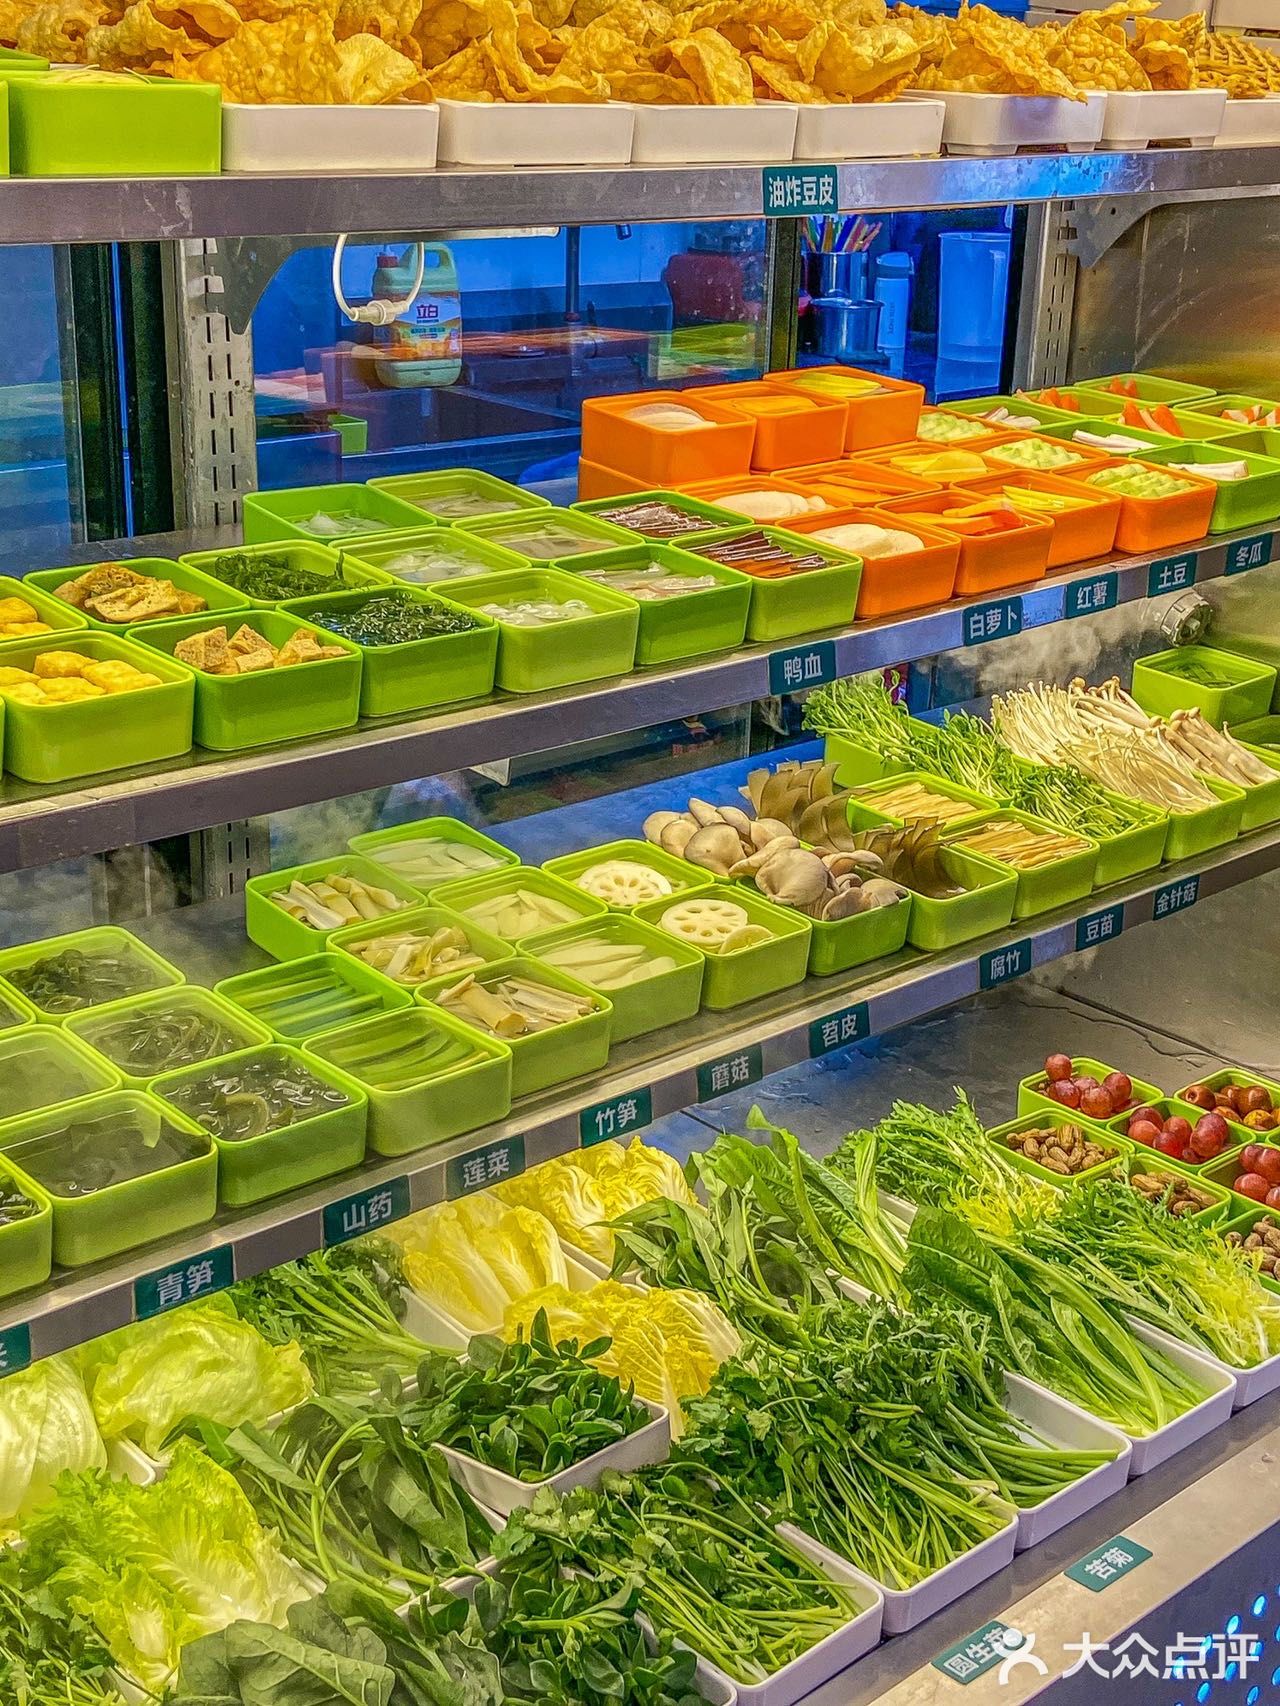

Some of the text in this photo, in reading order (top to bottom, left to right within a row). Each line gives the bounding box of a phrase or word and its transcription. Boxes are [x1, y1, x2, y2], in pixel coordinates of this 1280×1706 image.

[769, 175, 834, 208] 油炸豆皮
[416, 304, 438, 318] 立白
[1236, 542, 1262, 566] 冬瓜
[1158, 563, 1186, 589] 土豆
[1077, 581, 1108, 610] 红薯
[970, 605, 1017, 639] 白萝卜
[784, 654, 822, 684] 鸭血
[1156, 882, 1195, 914] 金针菇
[1085, 914, 1114, 942] 豆苗
[991, 951, 1021, 980] 腐竹
[821, 1014, 857, 1046] 苕皮
[711, 1056, 749, 1091] 蘑菇
[595, 1099, 637, 1135] 竹笋
[463, 1149, 509, 1187] 莲菜
[343, 1191, 392, 1232] 山药
[157, 1260, 214, 1304] 青笋
[1084, 1547, 1133, 1579] 苦菊
